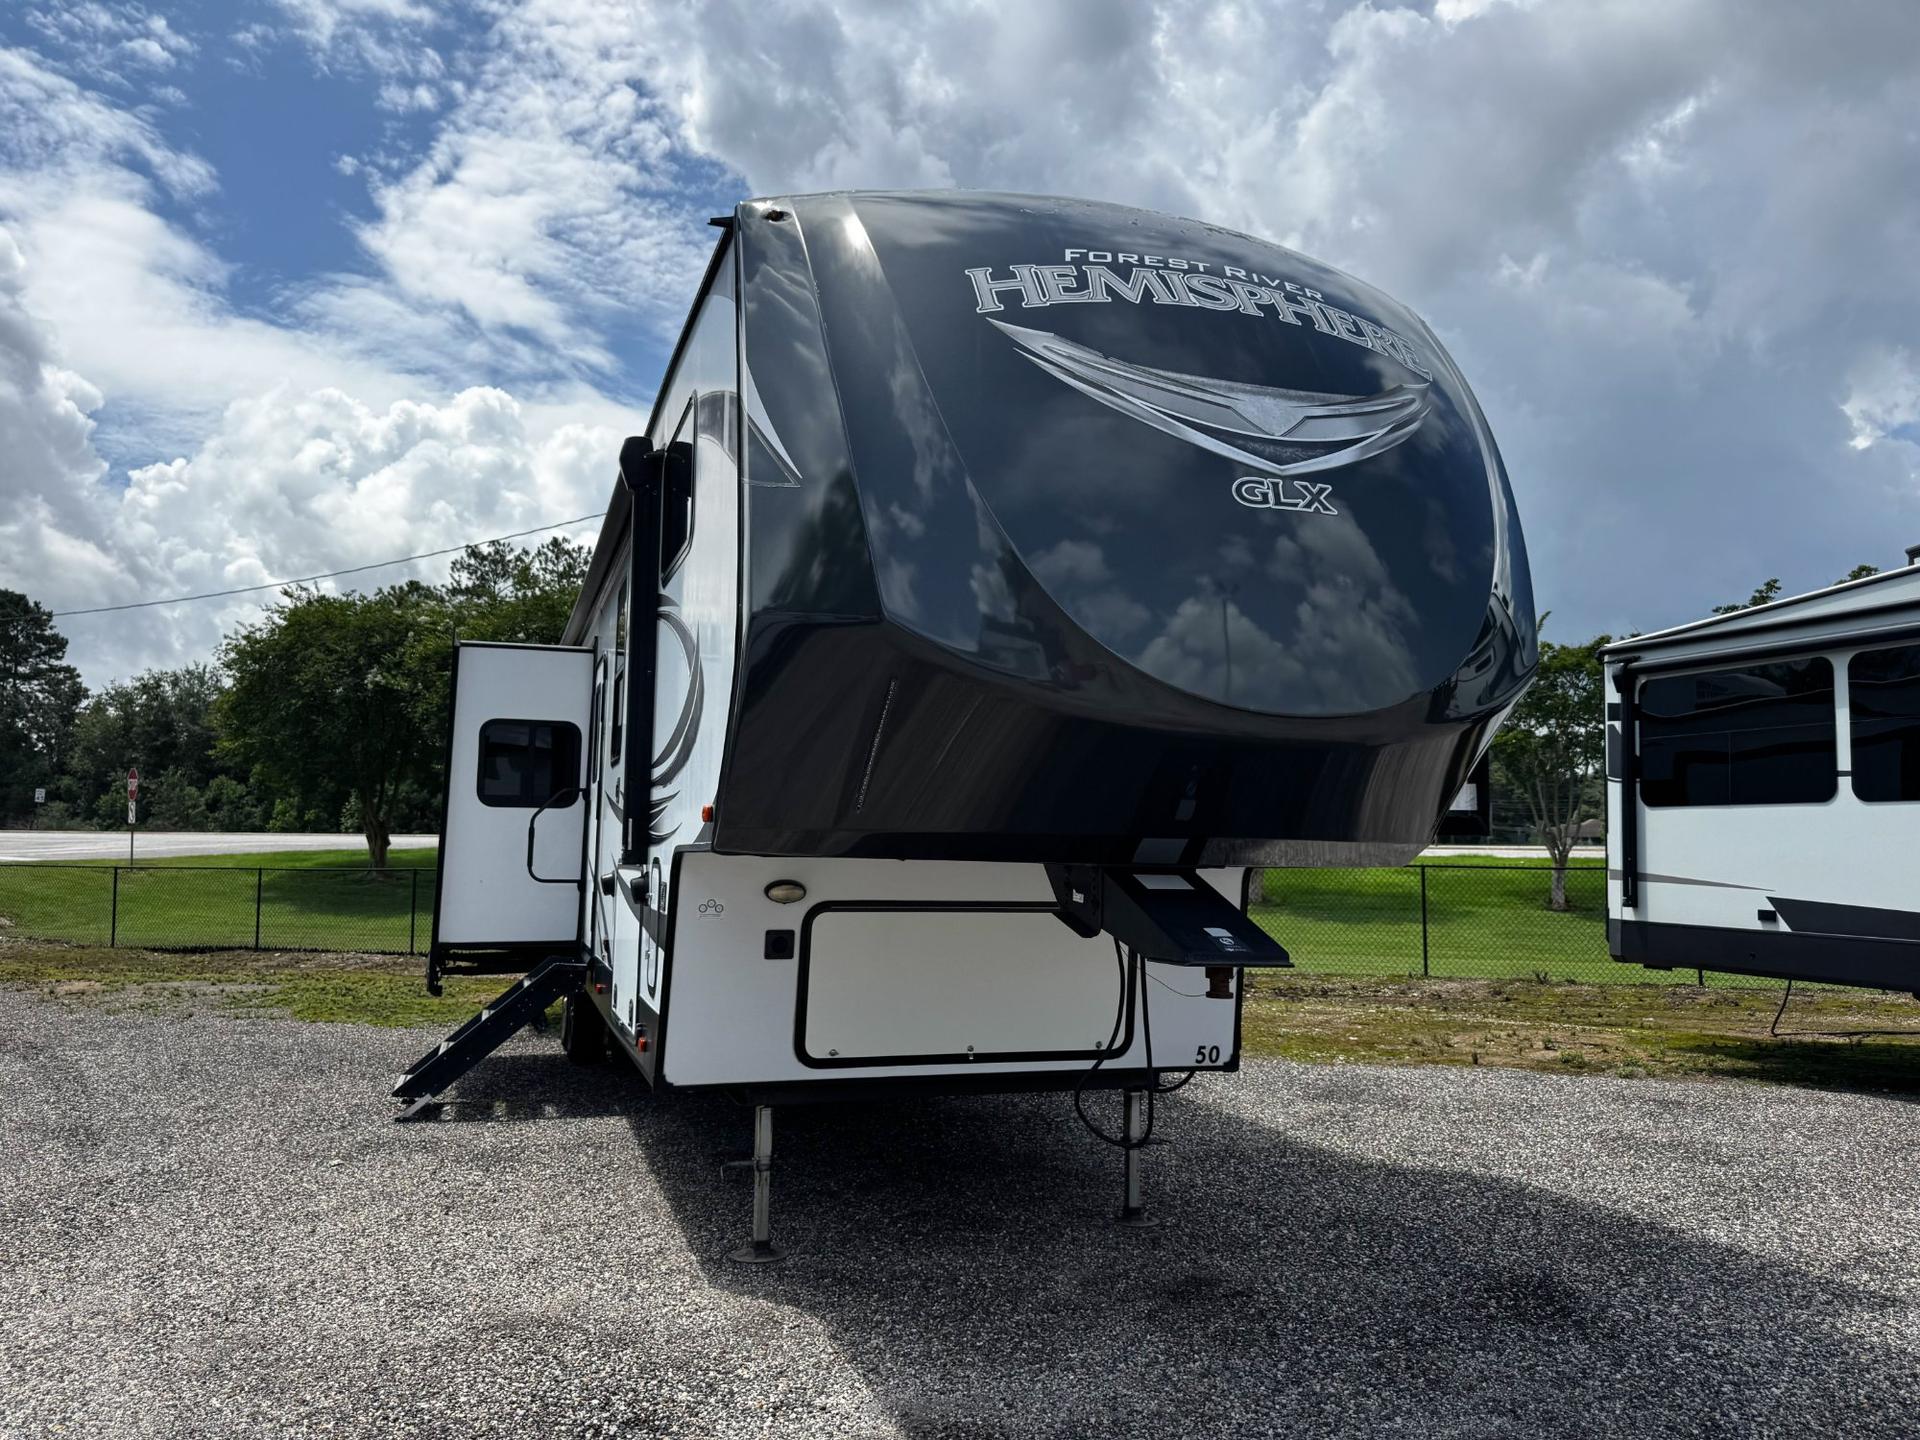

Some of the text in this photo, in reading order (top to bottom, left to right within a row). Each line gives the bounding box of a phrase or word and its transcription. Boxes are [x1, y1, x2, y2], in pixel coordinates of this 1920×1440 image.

[1064, 248, 1326, 303] FOREST RIVER
[965, 264, 1433, 382] HEMISPHERE
[1231, 476, 1338, 516] GLX
[1195, 1044, 1220, 1064] 50
